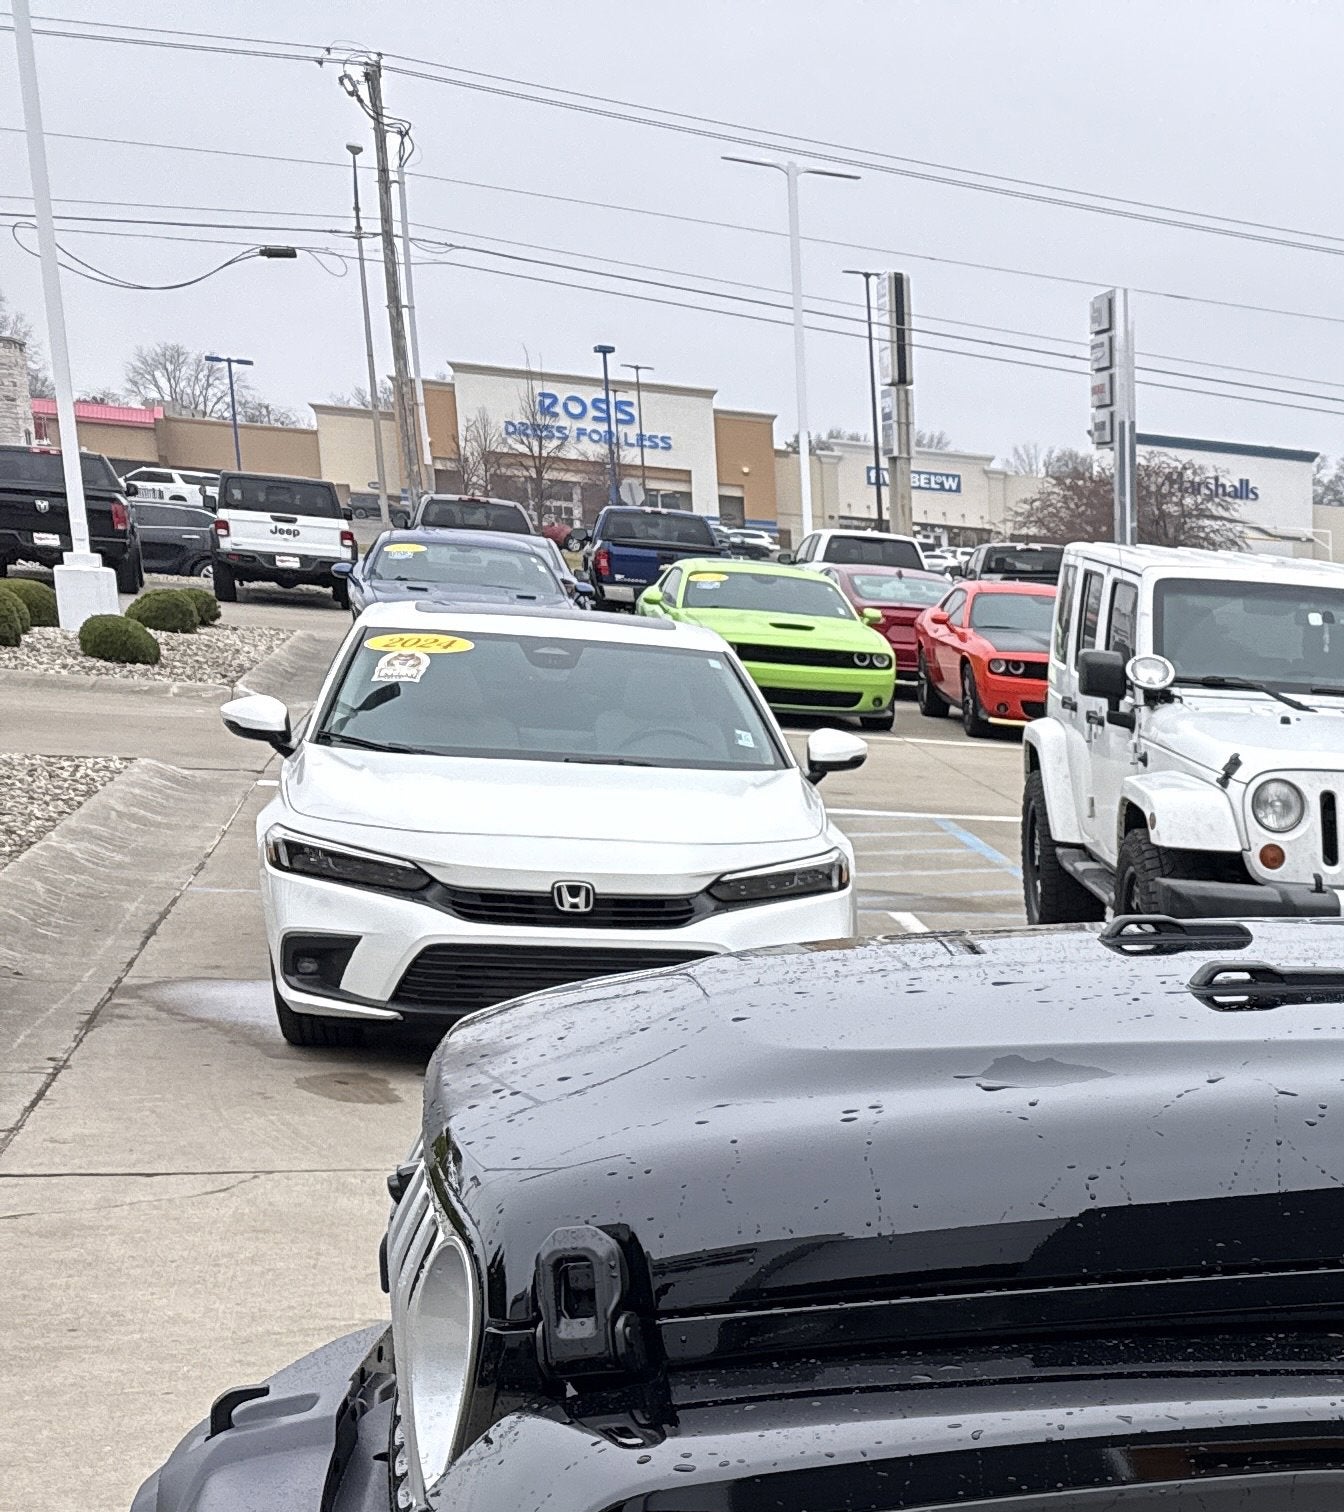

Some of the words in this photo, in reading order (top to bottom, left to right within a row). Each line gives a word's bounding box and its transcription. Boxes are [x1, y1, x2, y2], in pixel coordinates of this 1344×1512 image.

[538, 391, 635, 425] ROSS
[504, 420, 569, 441] DRESS
[576, 427, 615, 445] FOR
[624, 431, 673, 450] LESS
[911, 473, 959, 490] BELOW
[269, 525, 301, 538] Jeep
[382, 637, 457, 650] 2024
